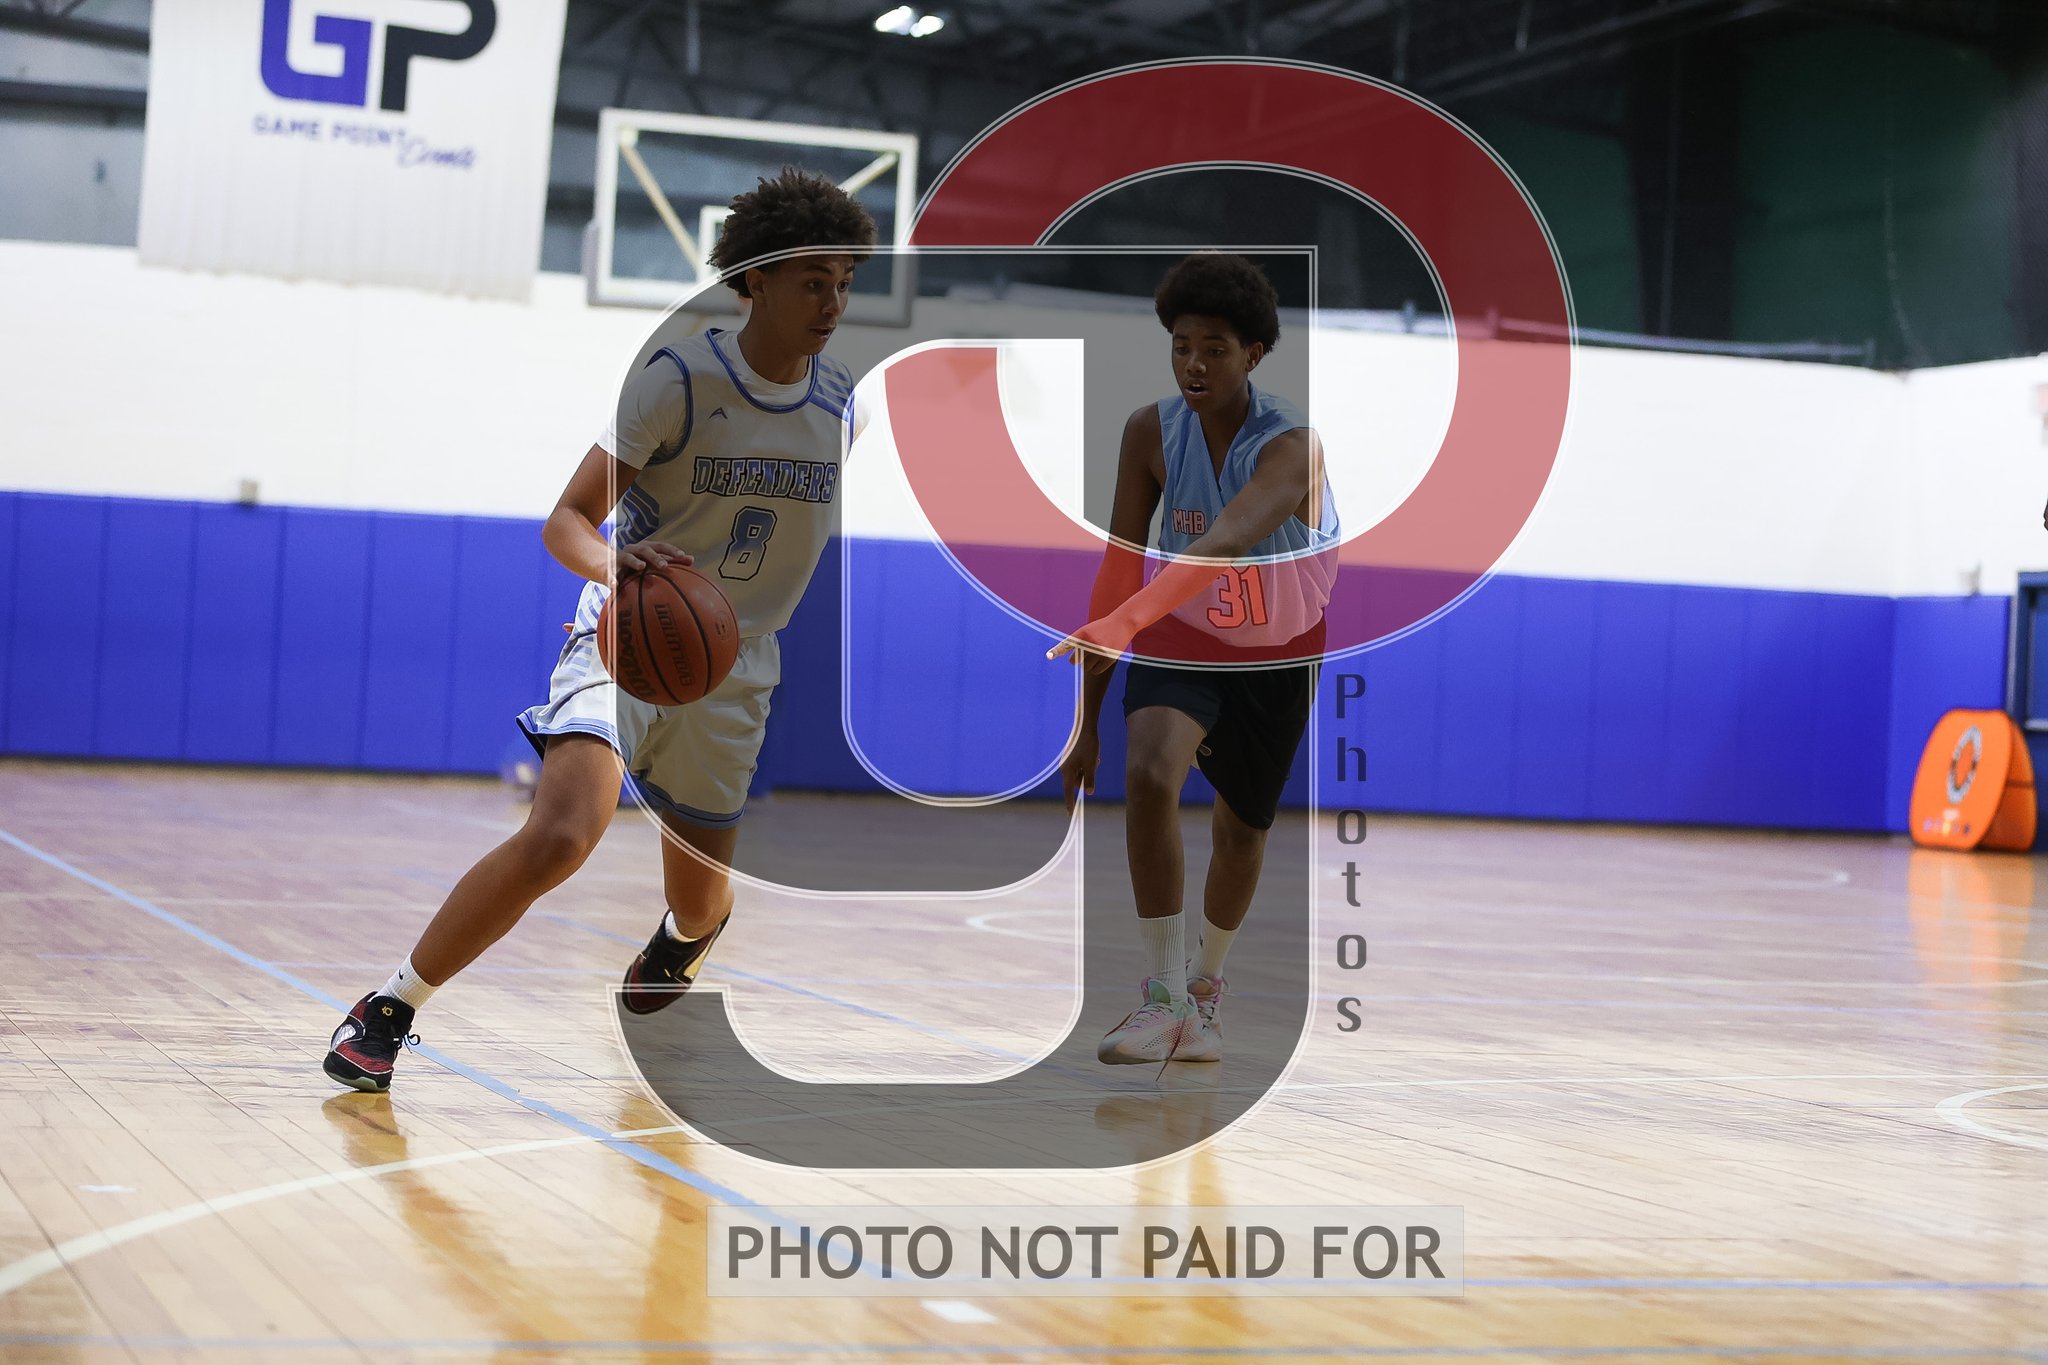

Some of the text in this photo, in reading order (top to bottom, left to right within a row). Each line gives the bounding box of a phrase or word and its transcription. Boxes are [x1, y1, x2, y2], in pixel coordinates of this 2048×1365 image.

[261, 0, 498, 112] GP
[692, 456, 838, 503] DEFENDERS
[718, 506, 777, 581] 8
[1173, 508, 1206, 535] MHB
[1207, 563, 1268, 629] 31
[654, 603, 696, 687] EVOLUTION
